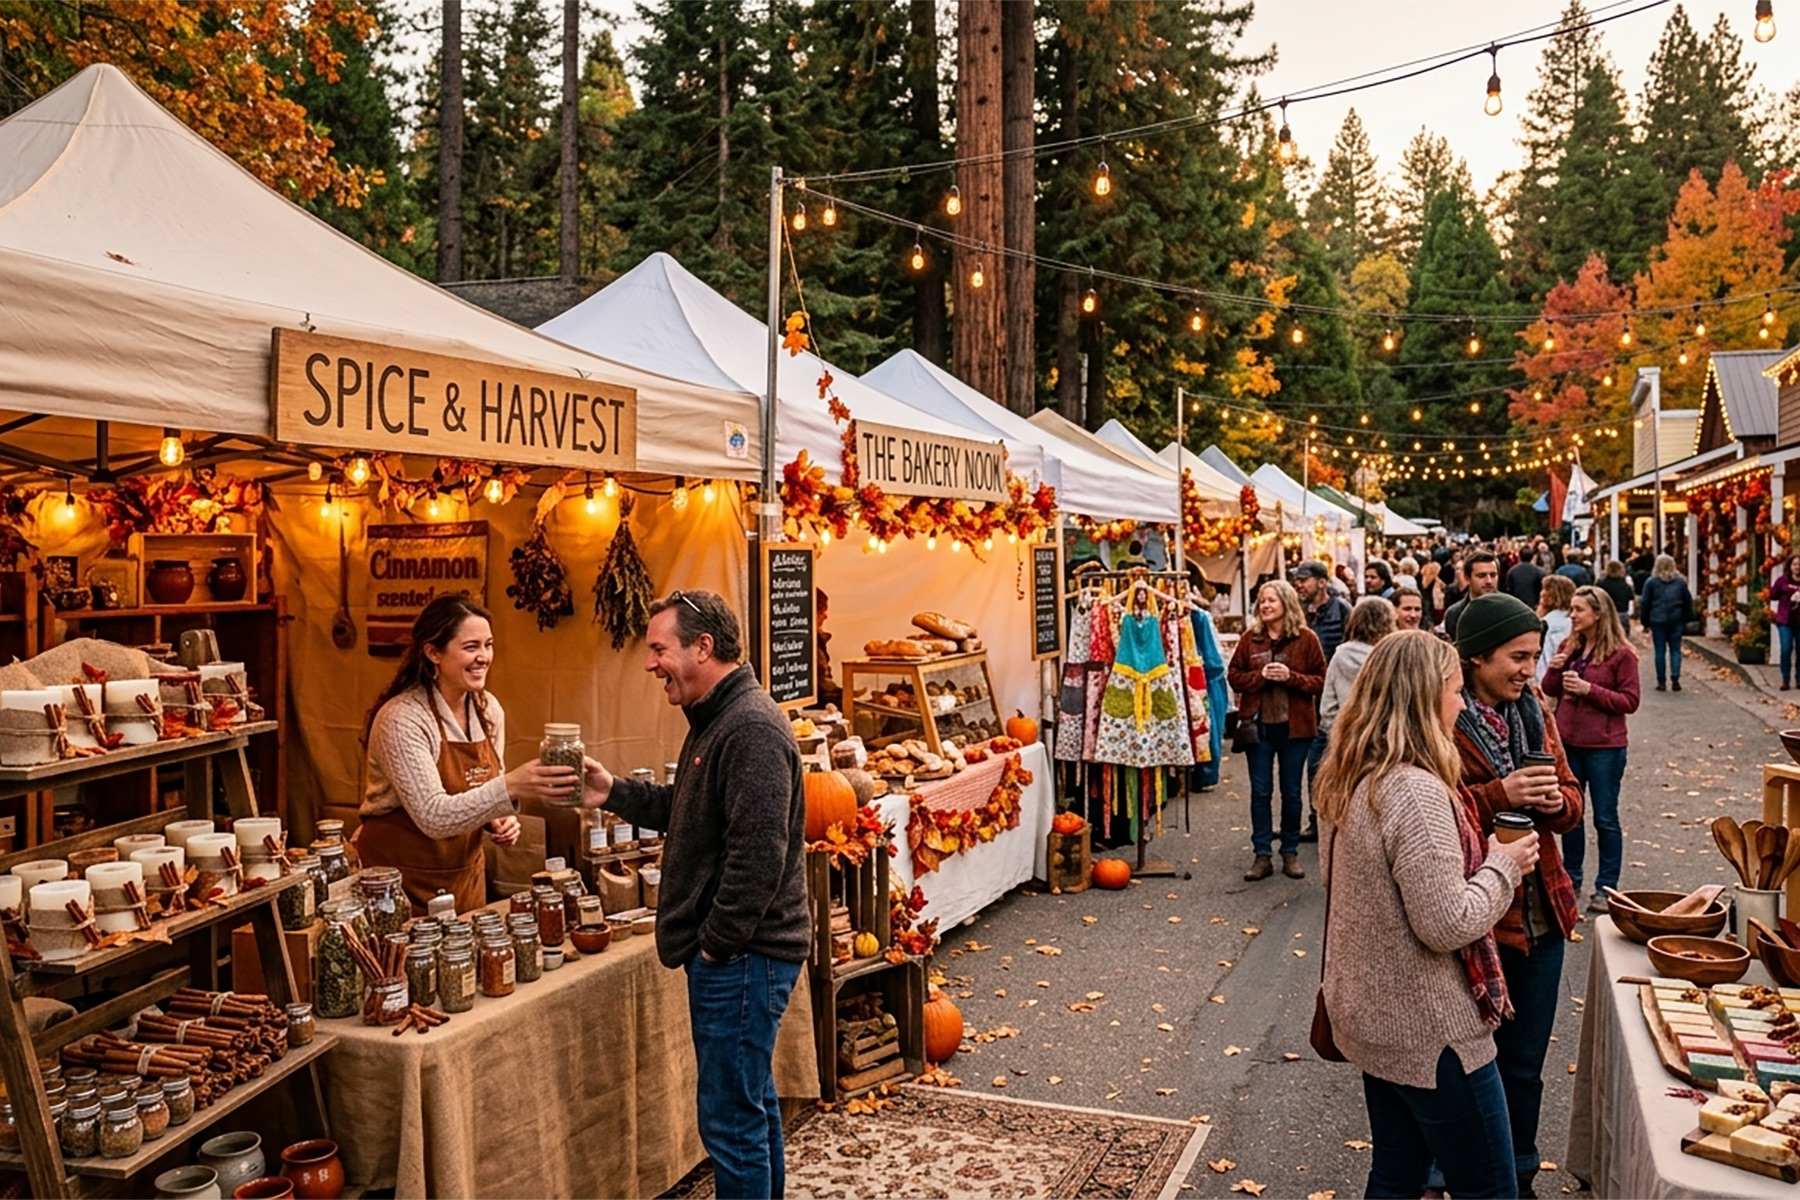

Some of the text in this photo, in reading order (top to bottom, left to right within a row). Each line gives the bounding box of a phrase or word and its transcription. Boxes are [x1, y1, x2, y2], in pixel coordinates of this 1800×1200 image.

[303, 353, 625, 455] SPICE & HARVEST
[862, 432, 1003, 493] THE BAKERY NOOK
